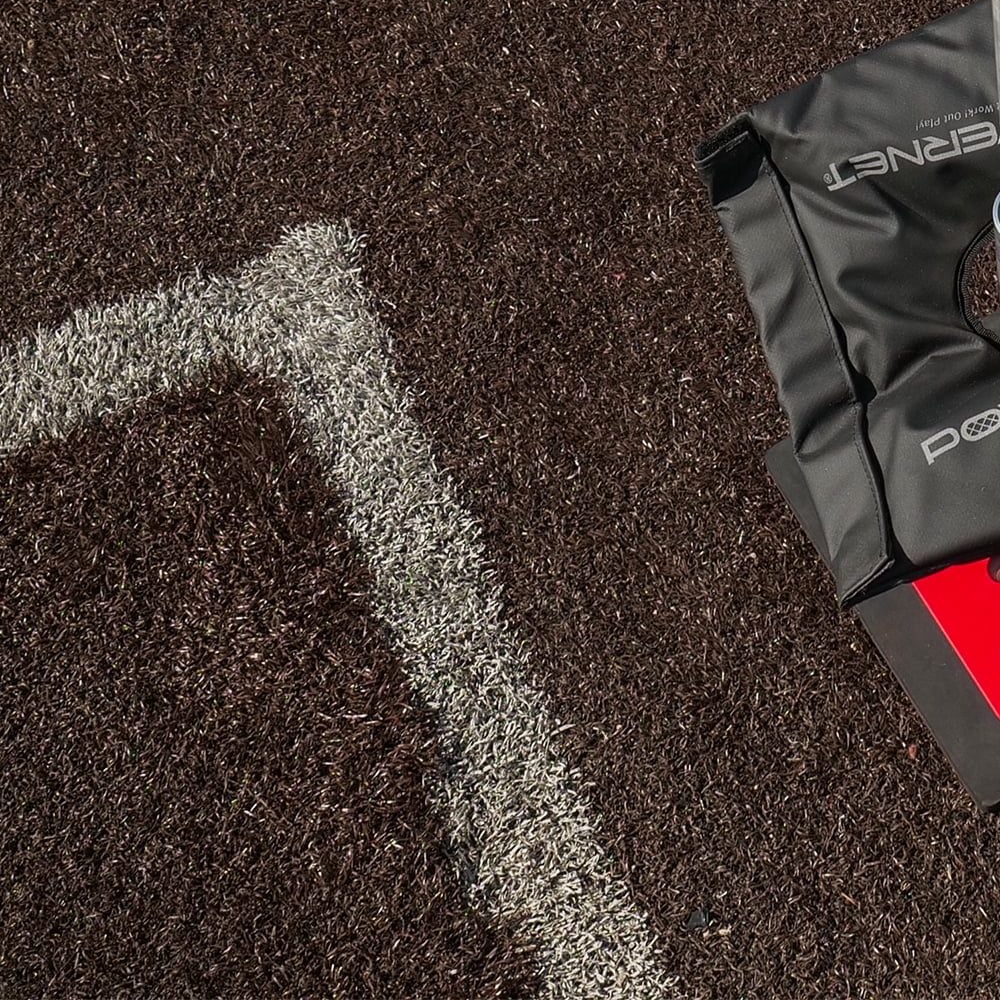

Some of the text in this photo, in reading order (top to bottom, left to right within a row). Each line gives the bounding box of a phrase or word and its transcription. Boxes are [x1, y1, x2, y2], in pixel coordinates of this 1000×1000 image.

[944, 111, 961, 123] Out
[965, 104, 994, 118] Work!
[915, 117, 940, 131] Play!
